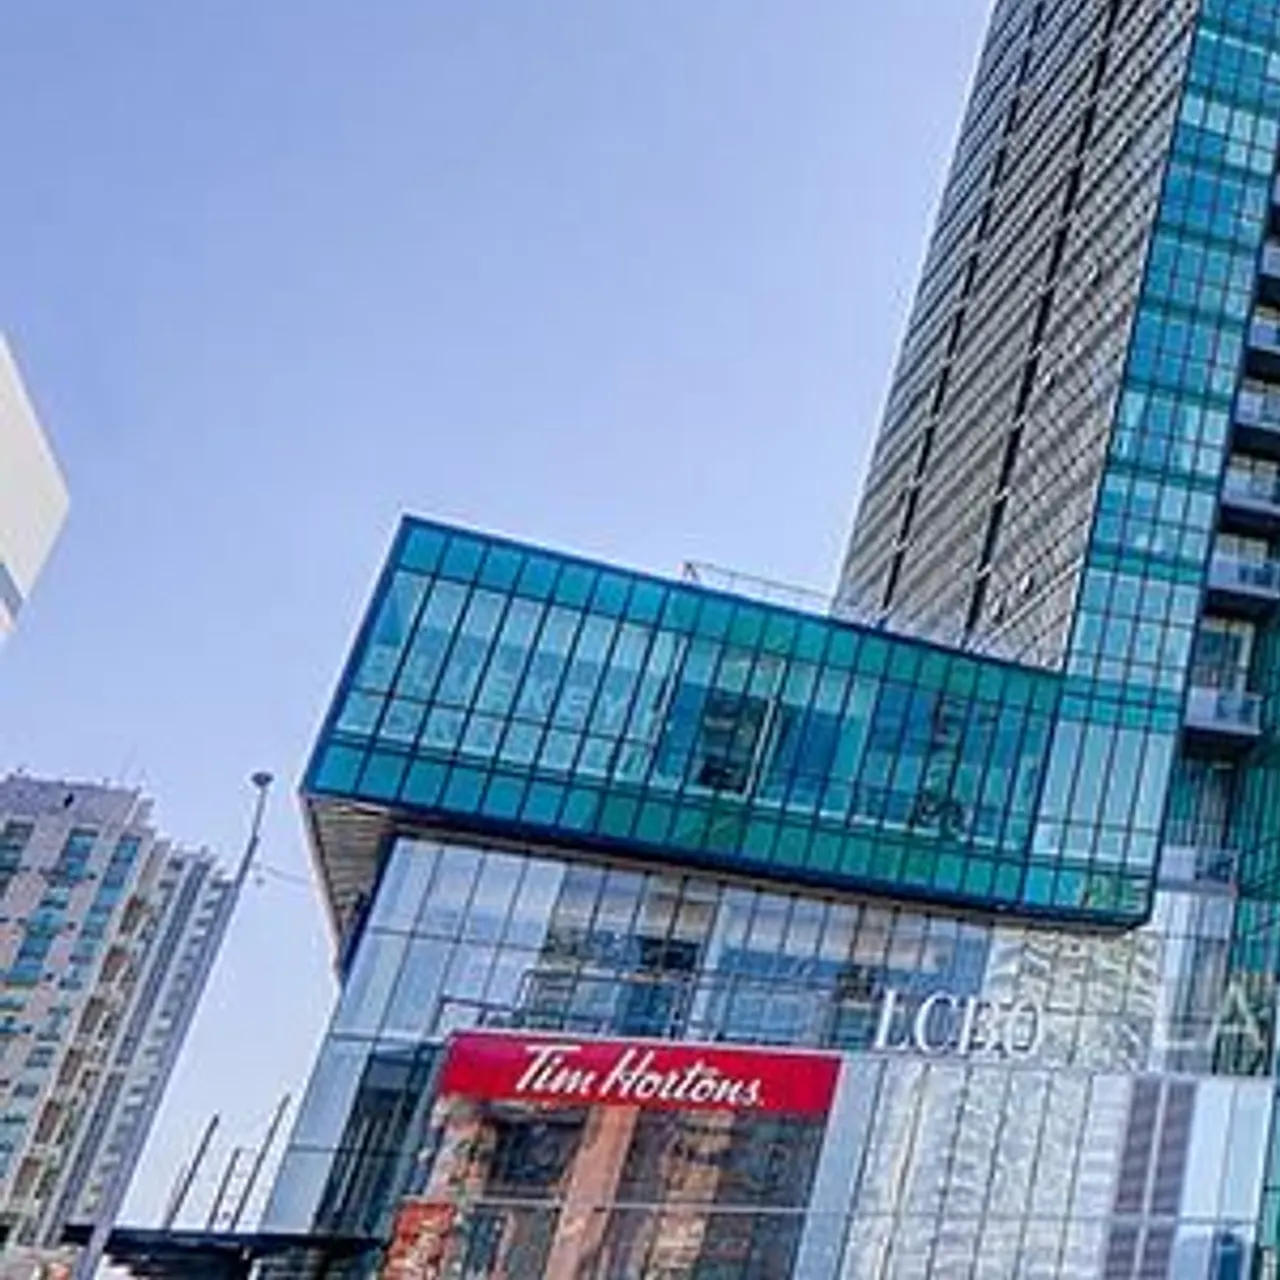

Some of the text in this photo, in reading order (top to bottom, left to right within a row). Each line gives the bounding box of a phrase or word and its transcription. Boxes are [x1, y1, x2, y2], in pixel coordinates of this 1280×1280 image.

[874, 988, 1043, 1058] LCBO
[515, 1045, 762, 1107] Tim Hortons
